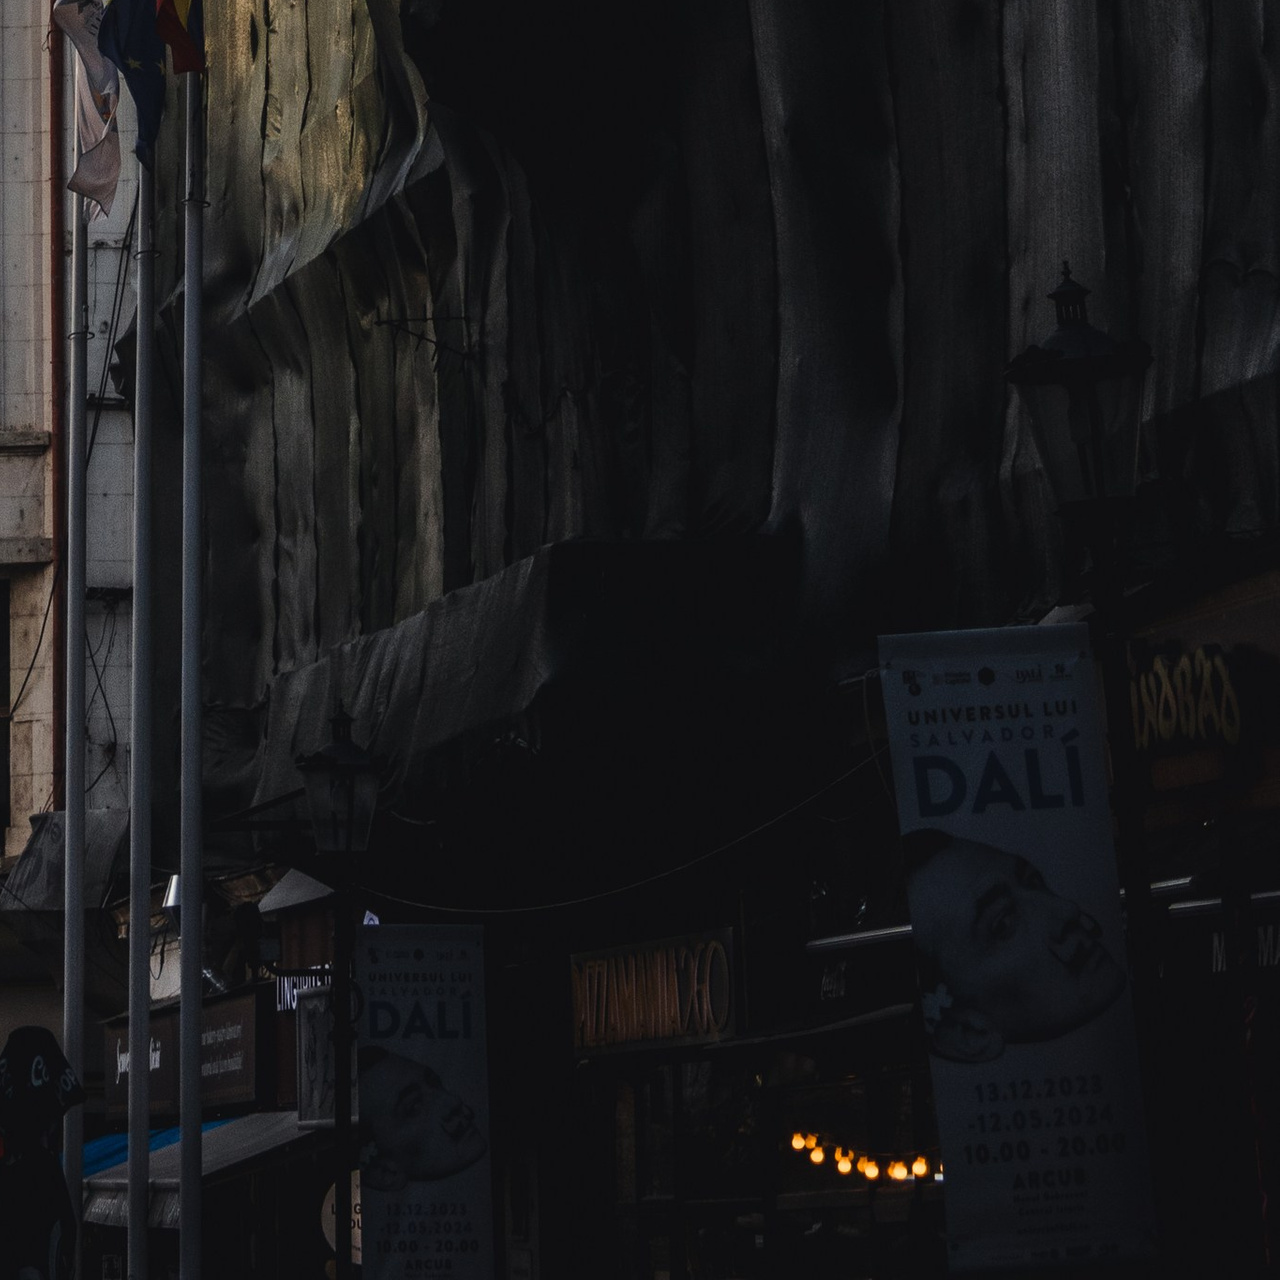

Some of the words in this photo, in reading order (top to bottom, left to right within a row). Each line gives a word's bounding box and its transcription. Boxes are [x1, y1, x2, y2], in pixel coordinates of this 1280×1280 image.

[907, 703, 1034, 725] UNIVERSUL
[1043, 700, 1078, 717] LUI
[909, 724, 1055, 748] SALVADOR
[913, 727, 1085, 818] DALÍ
[368, 972, 445, 983] UNIVERSUL
[451, 972, 473, 983] LUI
[368, 986, 457, 997] SALVADOR
[369, 990, 472, 1039] DALÍ
[974, 1074, 1103, 1103] 13.12.2023
[964, 1140, 1031, 1165] 10.00
[1013, 1168, 1087, 1190] ARCUB
[404, 1259, 453, 1270] ARCUB
